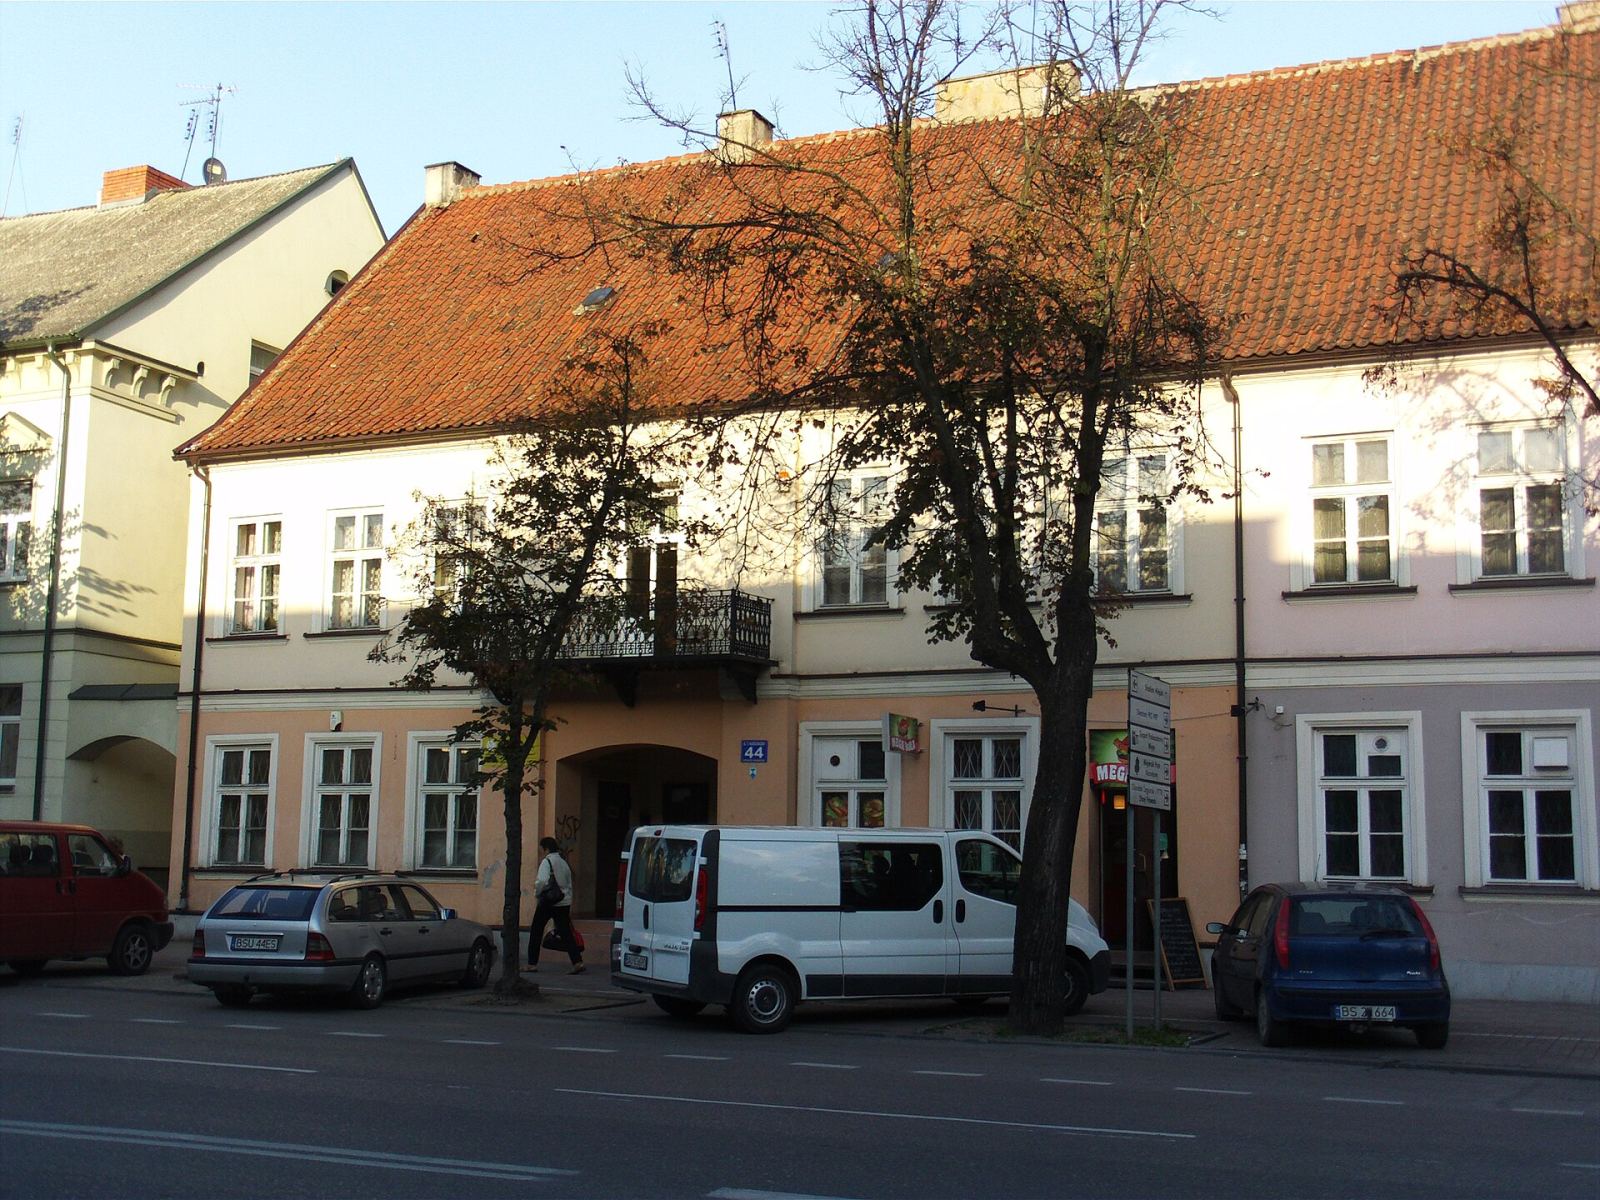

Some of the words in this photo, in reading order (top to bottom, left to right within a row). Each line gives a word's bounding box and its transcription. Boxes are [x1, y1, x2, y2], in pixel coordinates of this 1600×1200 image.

[744, 747, 764, 759] 44
[236, 938, 254, 949] BSU
[1341, 1007, 1357, 1018] BS
